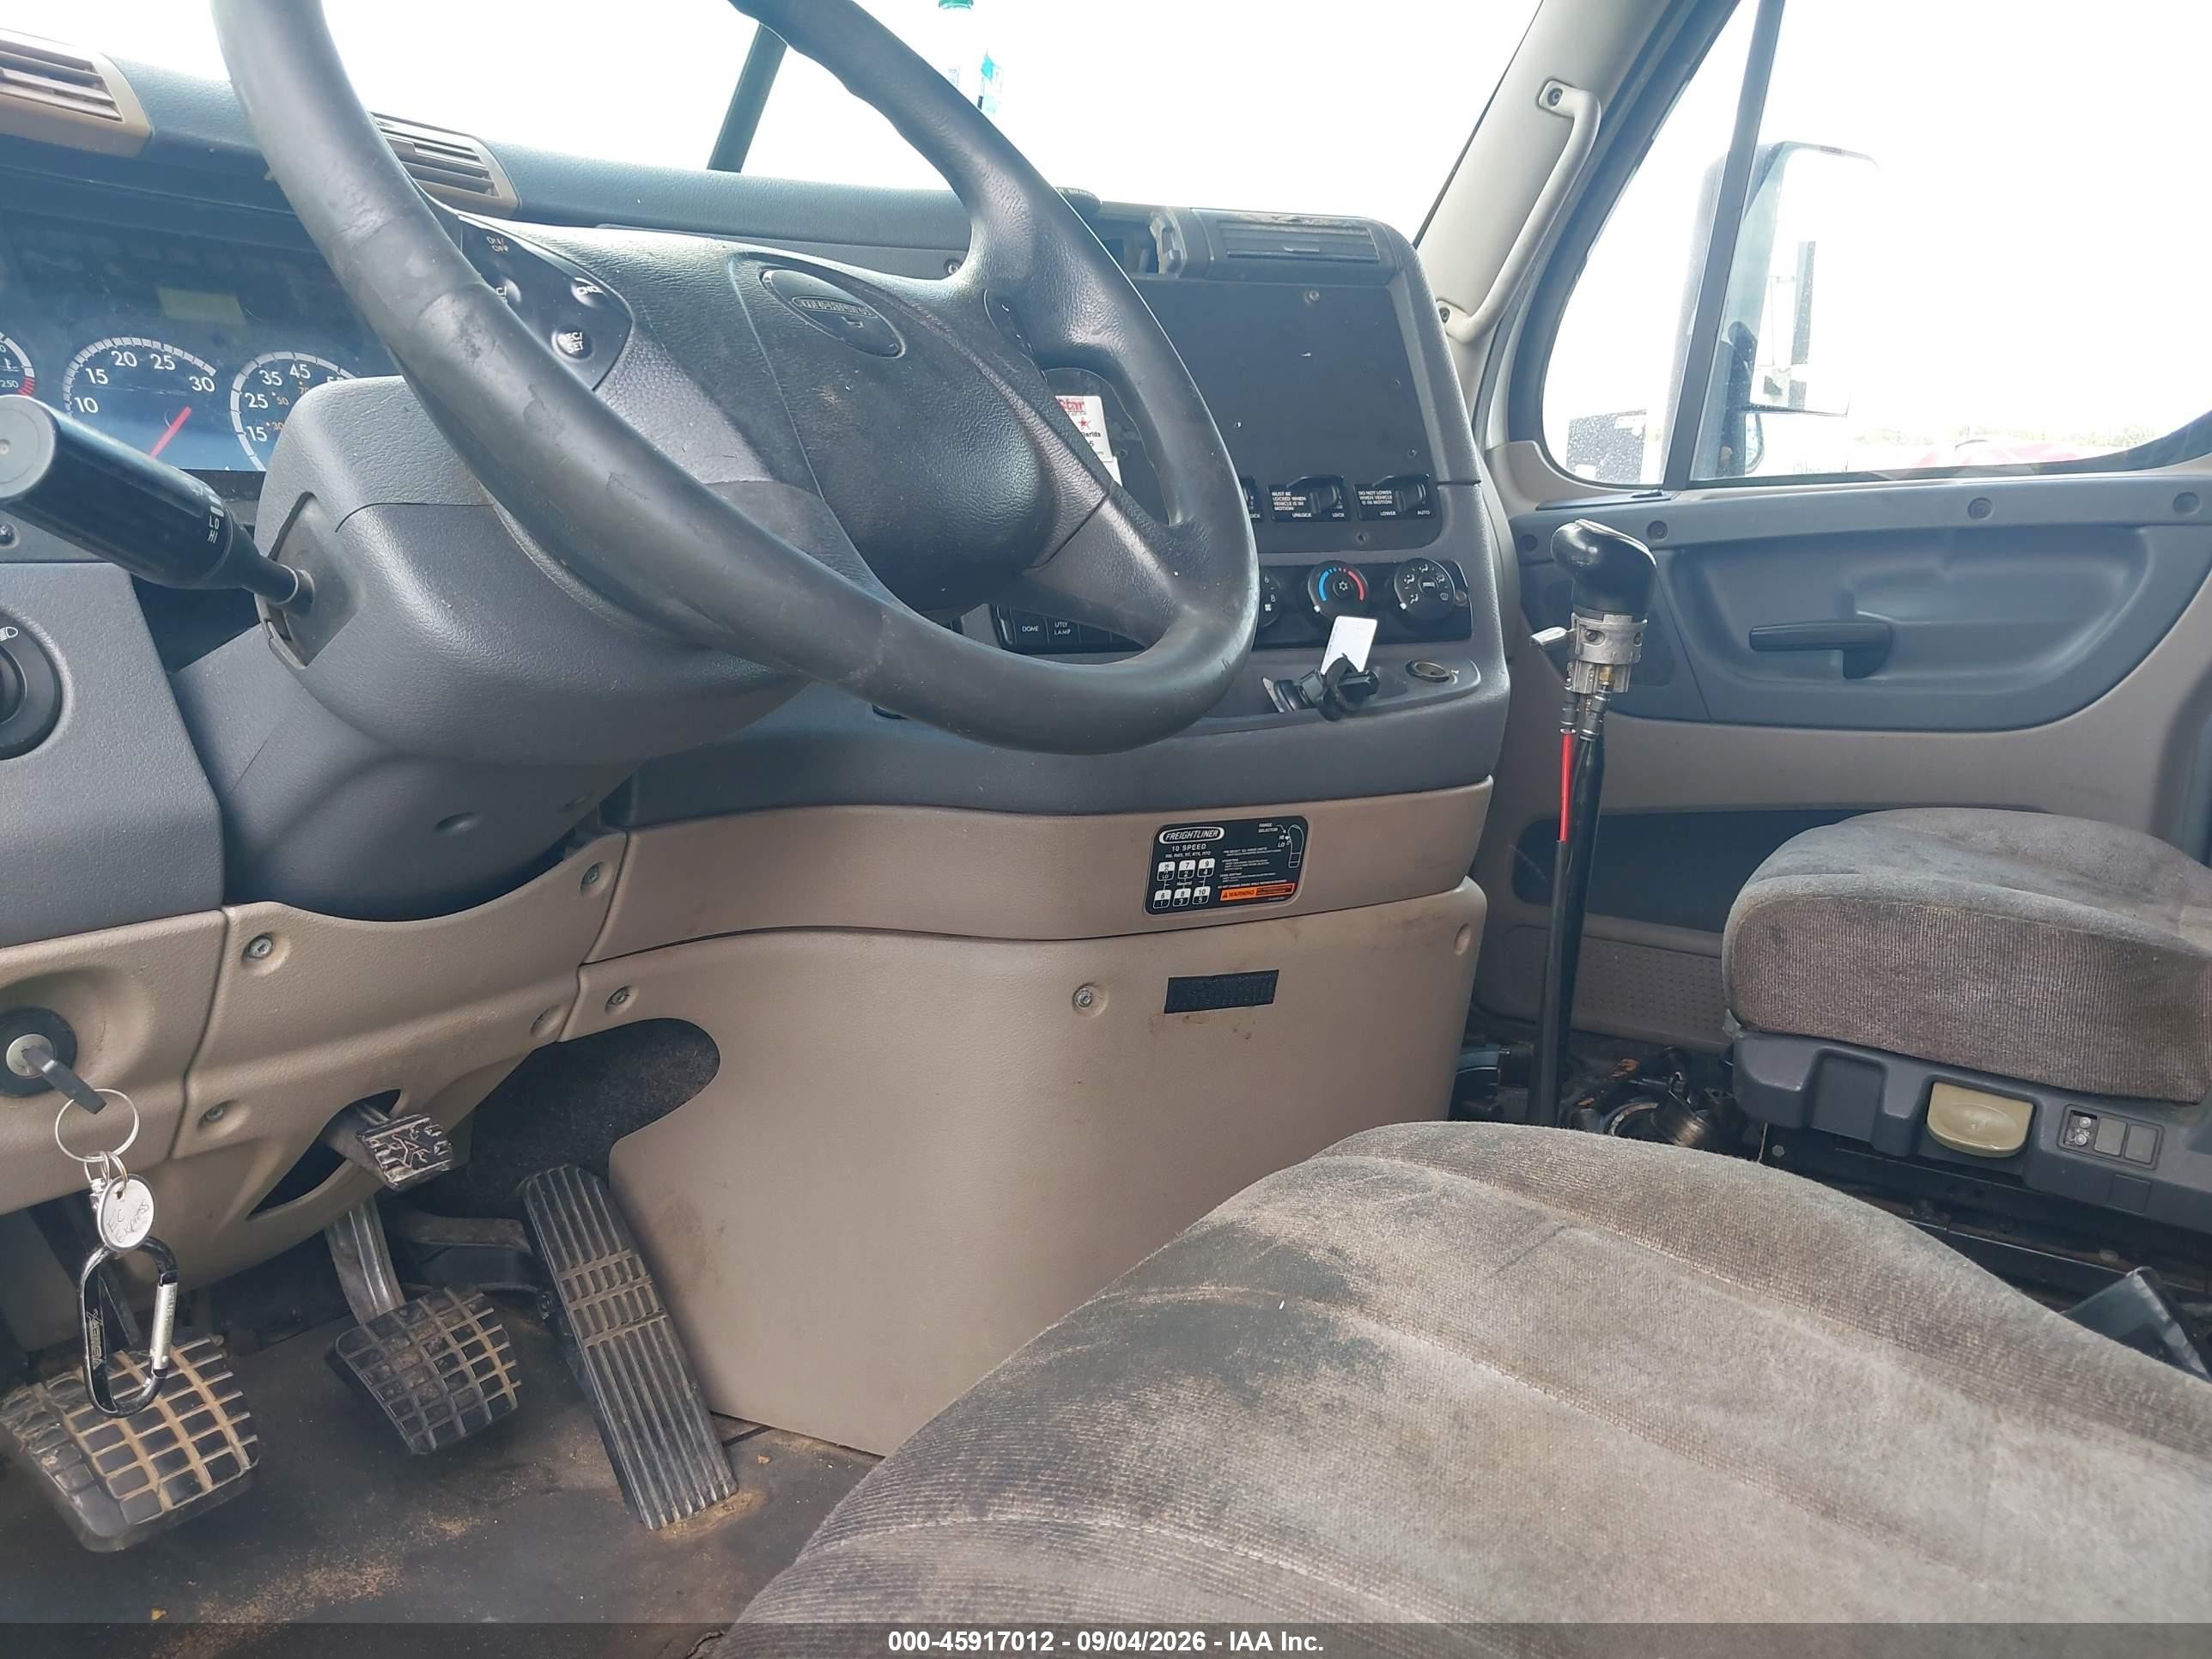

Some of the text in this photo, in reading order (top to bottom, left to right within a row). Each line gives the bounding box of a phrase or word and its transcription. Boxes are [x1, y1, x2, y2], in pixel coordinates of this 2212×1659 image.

[111, 350, 137, 368] 20
[150, 353, 176, 370] 25
[86, 368, 109, 385] 15
[258, 369, 283, 386] 35
[289, 363, 311, 380] 45
[1, 380, 19, 389] 250
[189, 376, 216, 392] 30
[74, 397, 99, 413] 10
[245, 392, 269, 409] 25
[276, 397, 289, 406] 50
[246, 425, 268, 442] 15
[209, 515, 220, 530] LO
[207, 529, 218, 544] HI
[1164, 830, 1218, 842] FREIGHTLINER
[1182, 843, 1206, 852] SPEED
